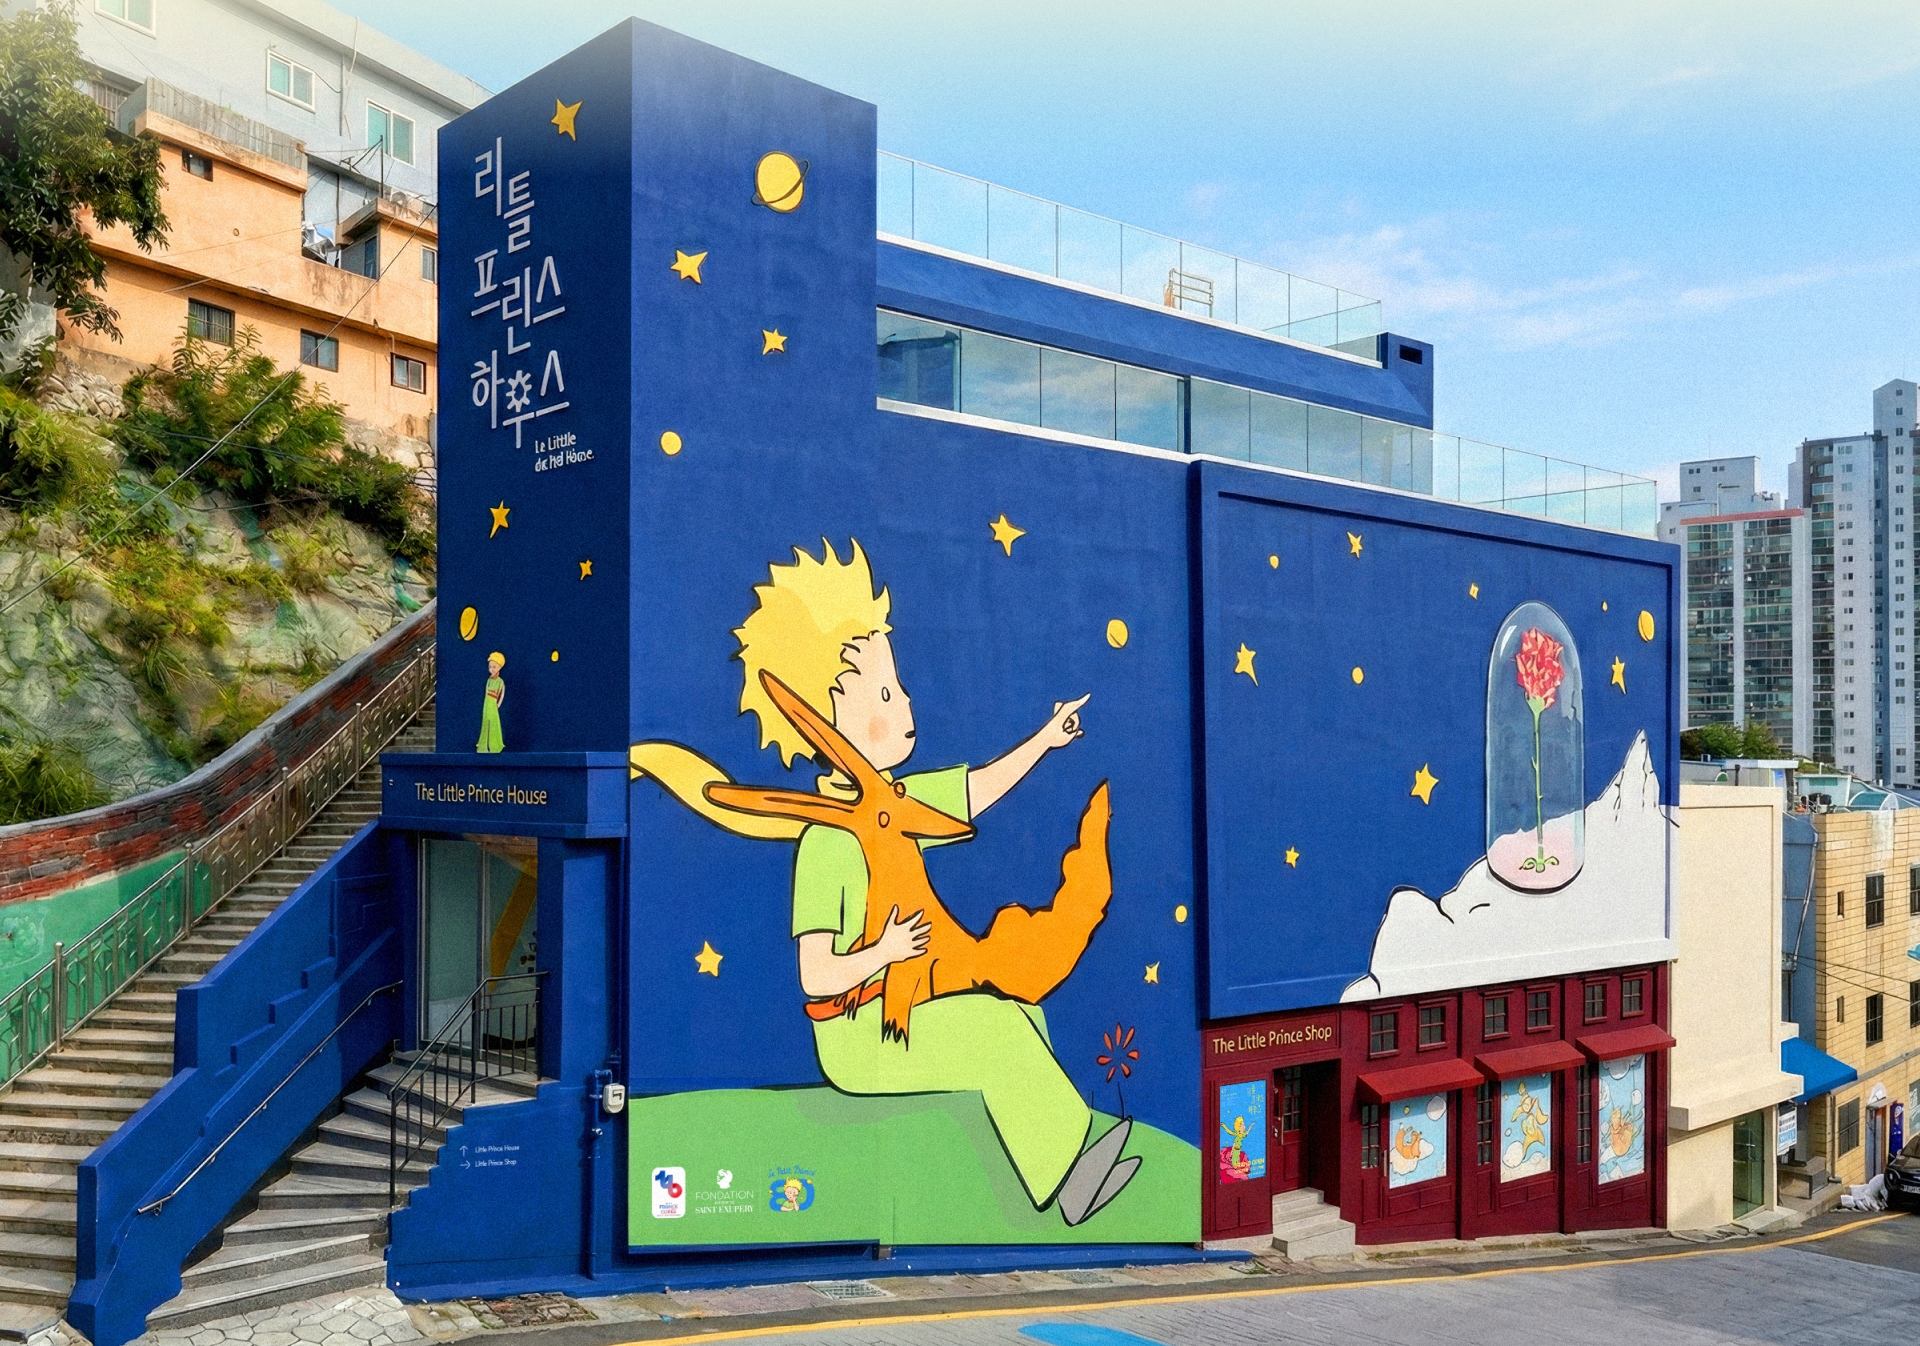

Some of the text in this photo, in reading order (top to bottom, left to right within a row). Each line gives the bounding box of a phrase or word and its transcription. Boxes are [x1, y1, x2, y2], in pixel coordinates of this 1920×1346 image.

[475, 136, 535, 254] 리틀
[471, 249, 566, 355] 프린스
[470, 350, 570, 449] 하우스
[547, 431, 577, 451] Little
[415, 782, 547, 805] The Little Prince House
[1213, 1024, 1332, 1054] The Little Prince Shop
[488, 1159, 503, 1167] Prince
[504, 1158, 517, 1166] Shop
[695, 1190, 754, 1200] FONDATION
